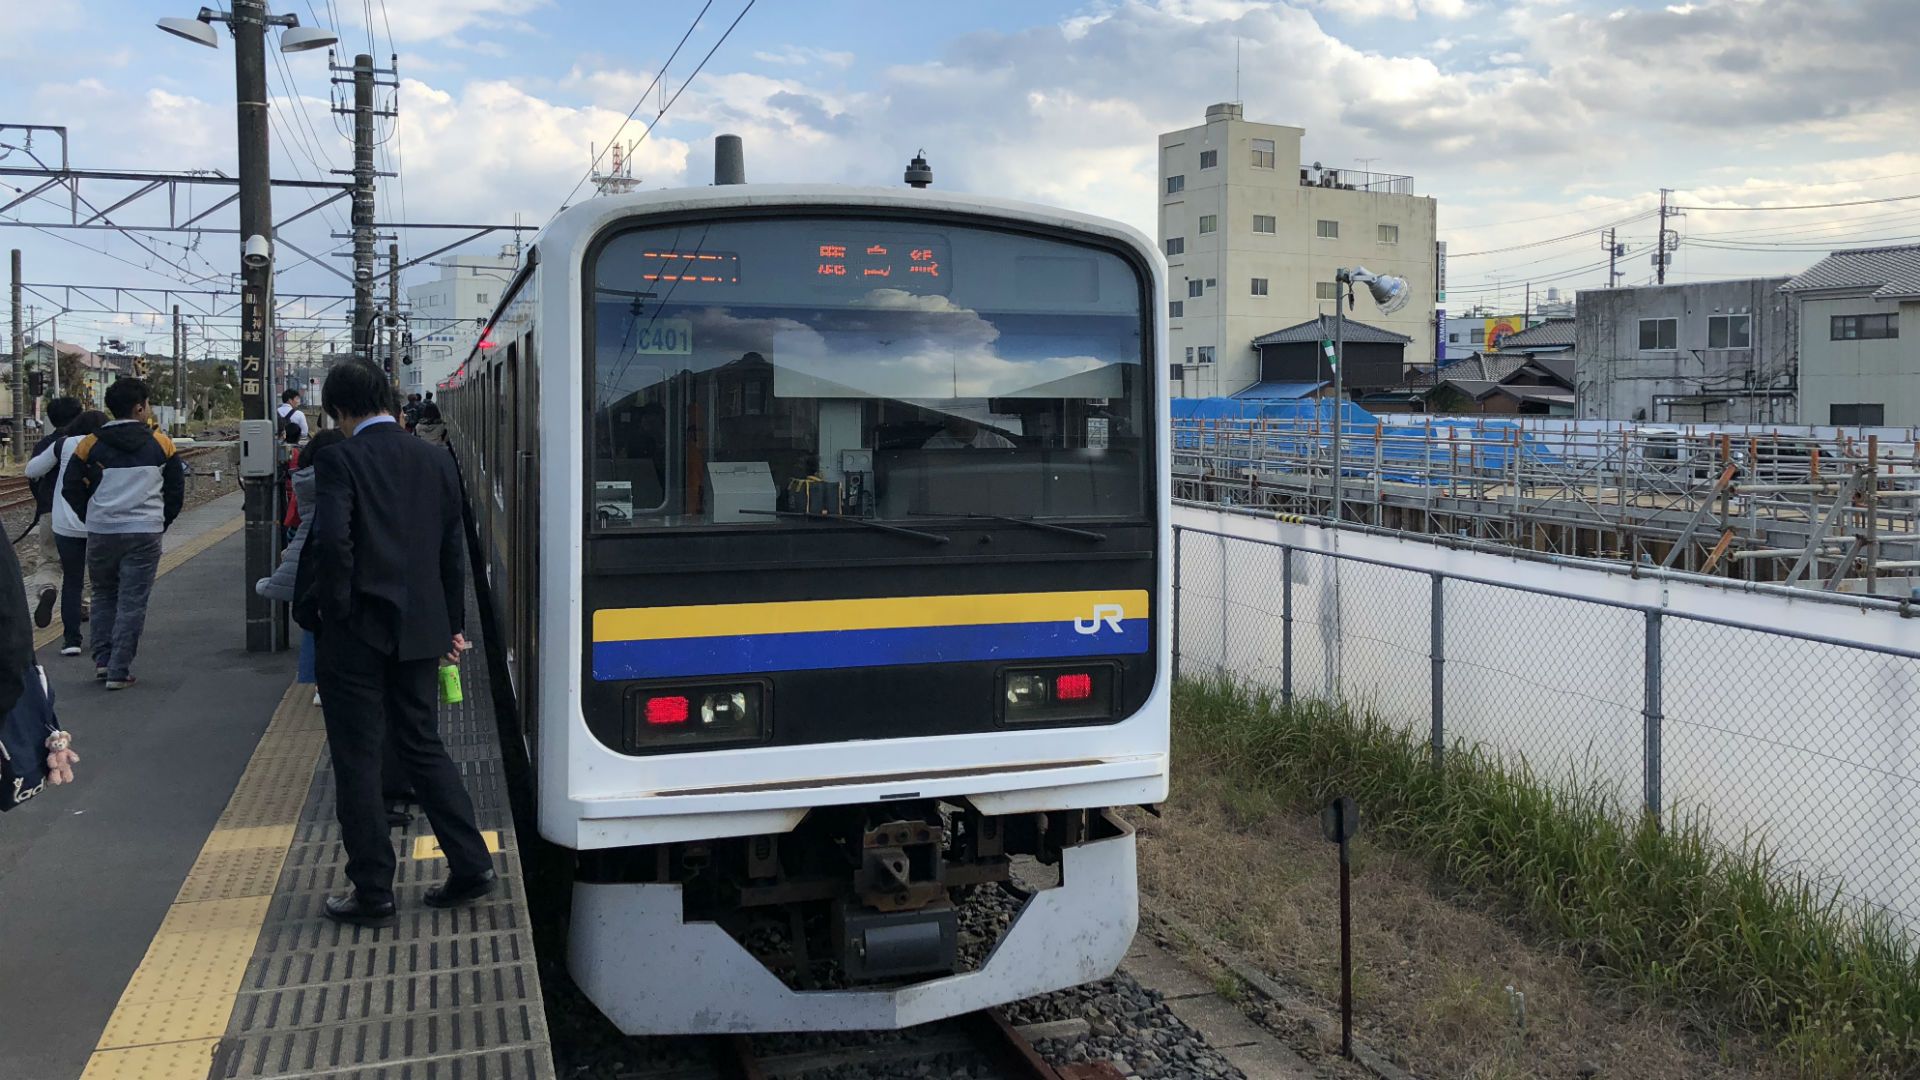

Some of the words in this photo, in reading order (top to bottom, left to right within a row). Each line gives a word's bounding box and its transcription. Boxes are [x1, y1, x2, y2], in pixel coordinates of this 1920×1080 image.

[640, 327, 688, 352] C401
[1438, 313, 1446, 344] YAMAHA
[243, 354, 260, 396] 方面
[1074, 603, 1124, 635] JR
